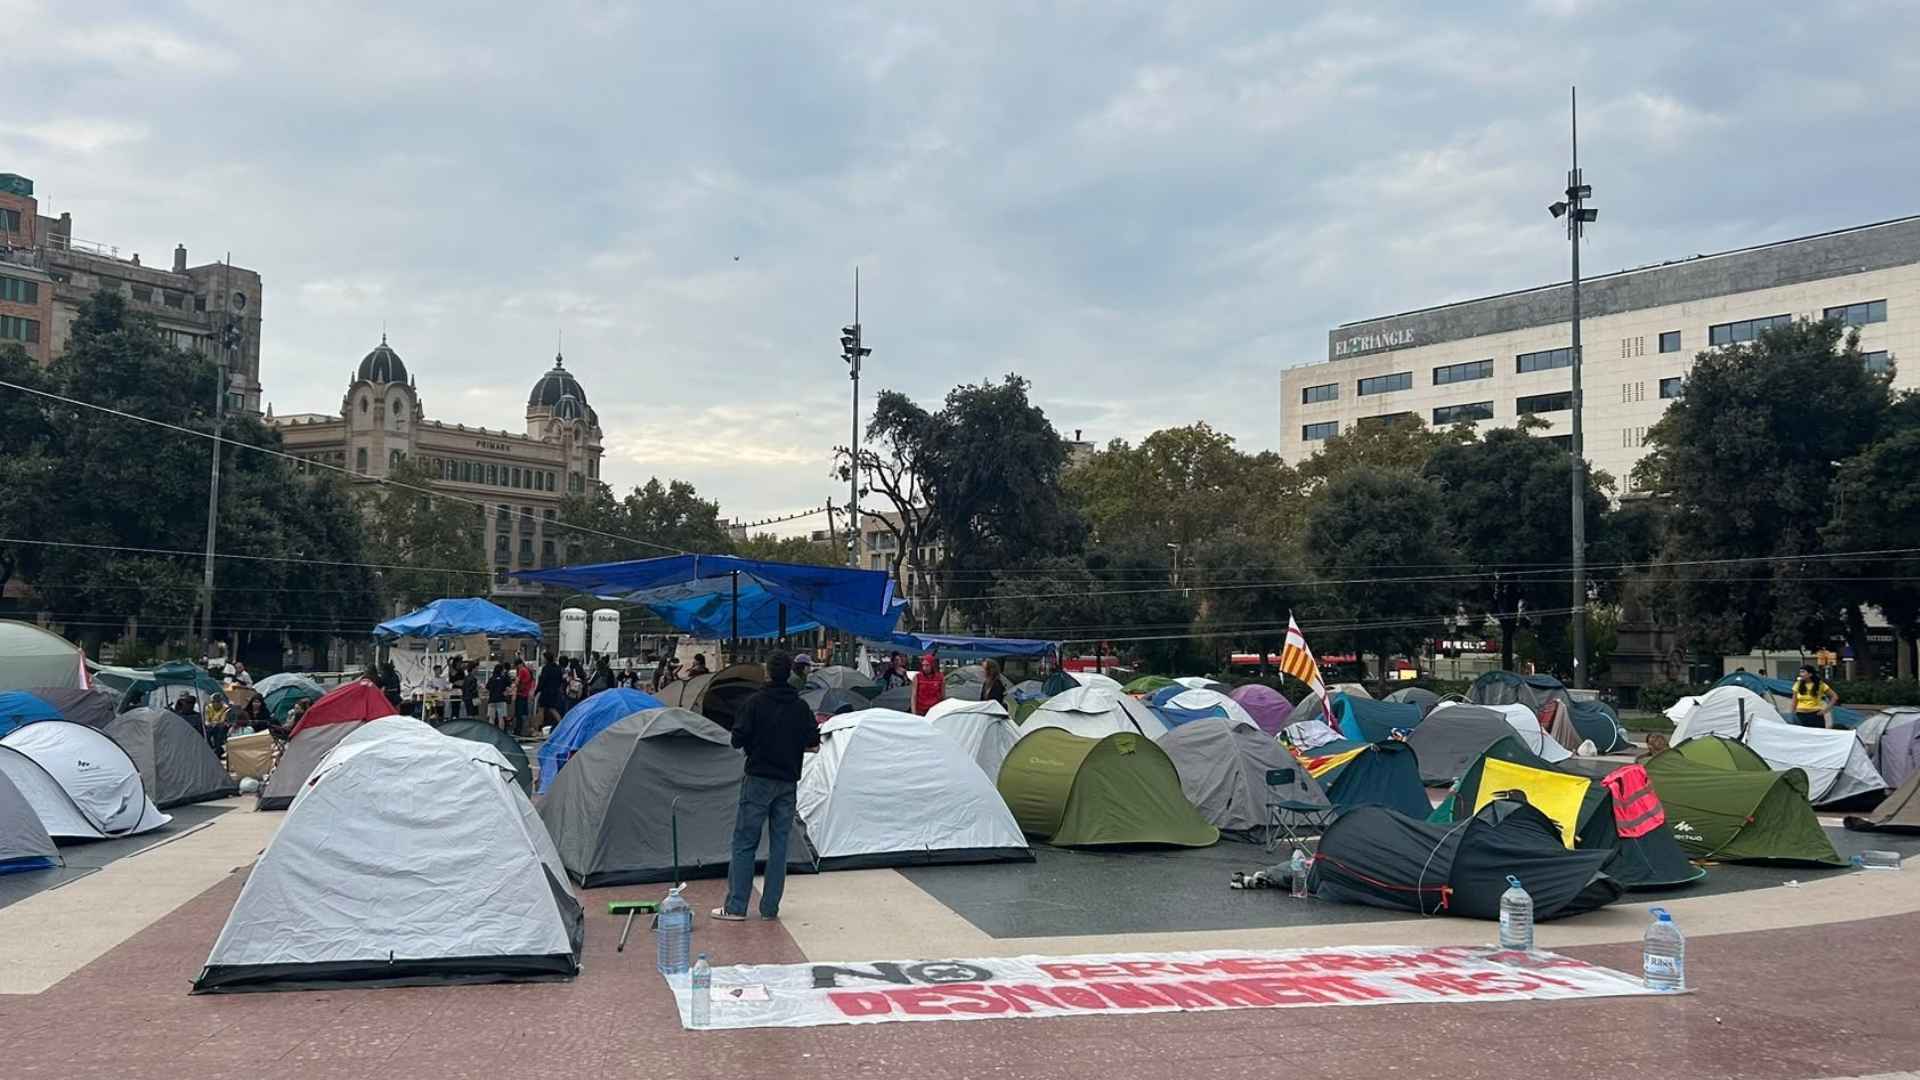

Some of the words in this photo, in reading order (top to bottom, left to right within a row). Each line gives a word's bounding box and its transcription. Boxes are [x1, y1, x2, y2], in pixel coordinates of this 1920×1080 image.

[1335, 340, 1350, 356] EL
[1350, 328, 1415, 353] TRIANGLE
[812, 962, 993, 989] NO
[1037, 954, 1462, 980] PERMETREM
[827, 976, 1391, 1016] DESNONAMENT
